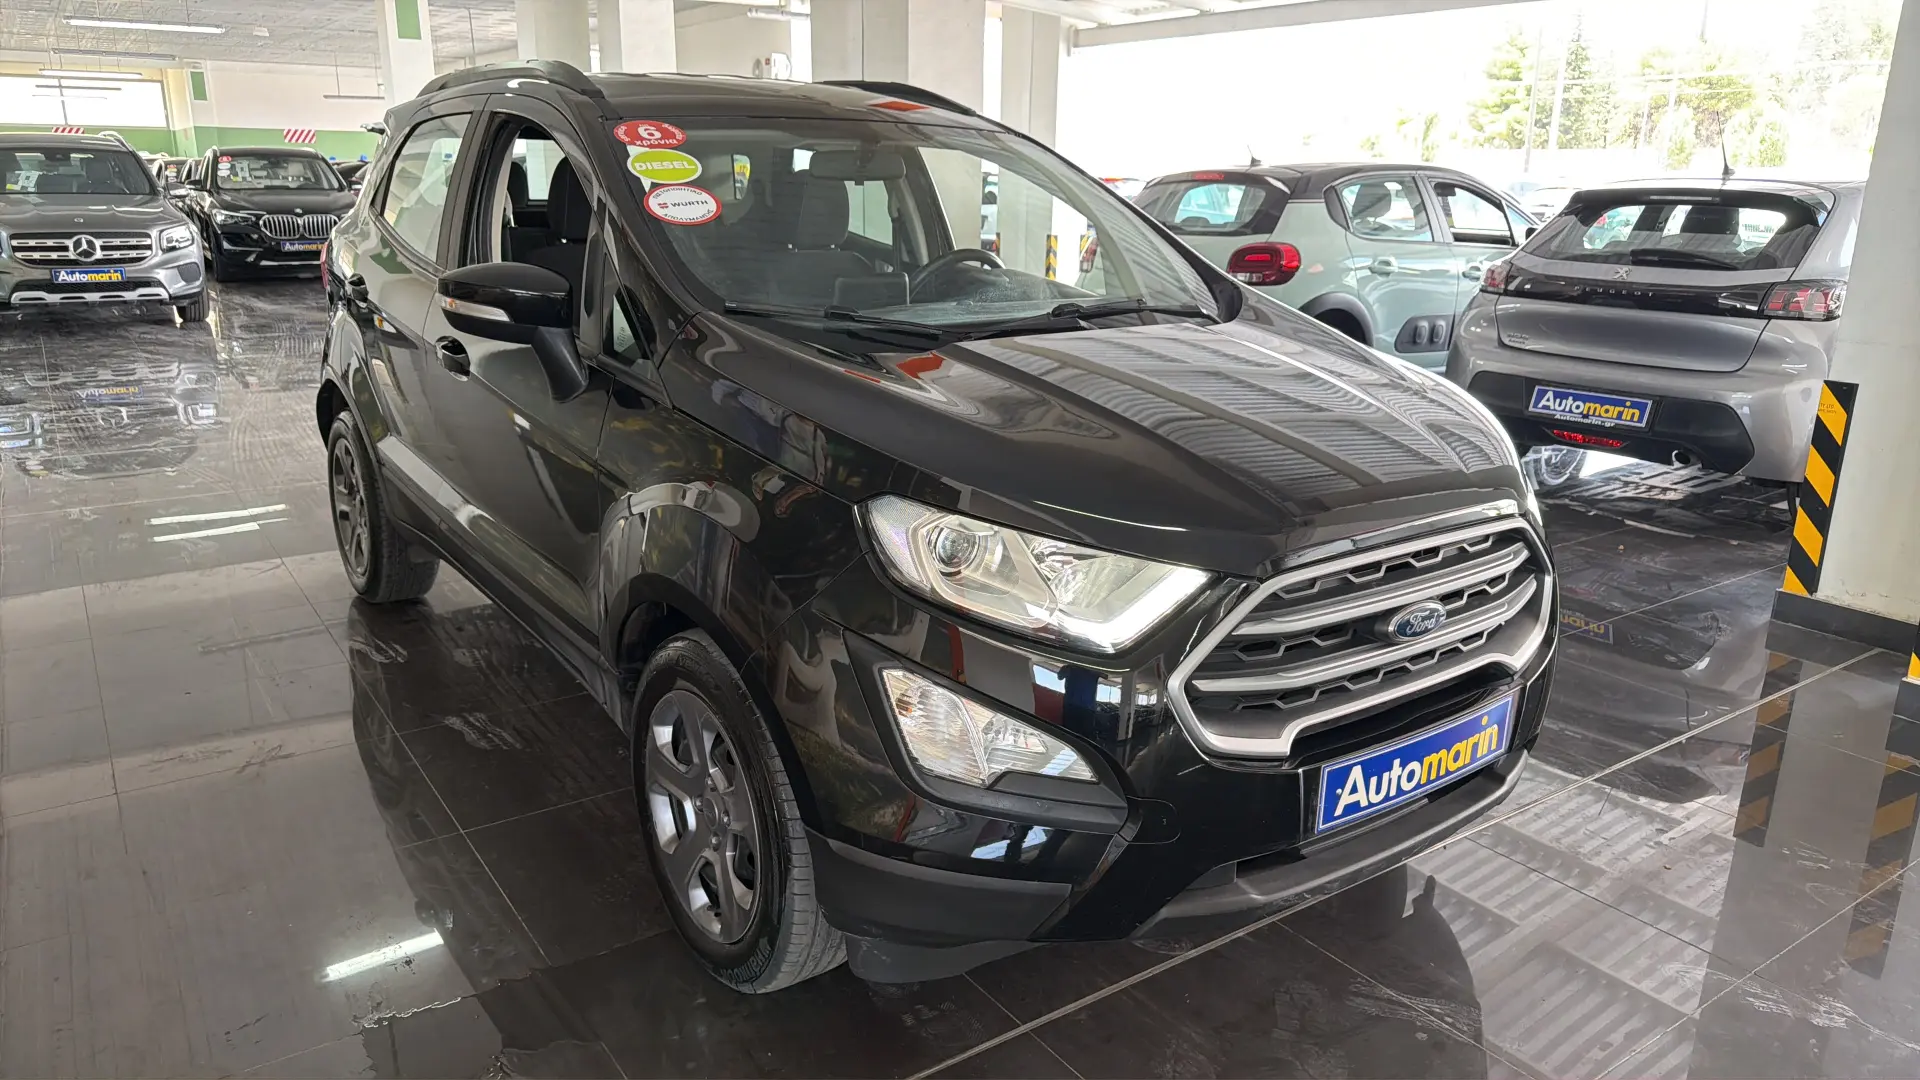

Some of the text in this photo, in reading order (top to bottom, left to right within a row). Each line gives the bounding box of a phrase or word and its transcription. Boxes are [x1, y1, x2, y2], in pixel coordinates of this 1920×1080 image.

[638, 126, 662, 140] 6
[634, 161, 695, 171] DIESEL
[59, 270, 122, 281] Automarin
[1574, 286, 1653, 297] PEUGEOT
[1537, 391, 1640, 421] Automarin
[1554, 414, 1616, 427] Automarin.gr
[1406, 612, 1437, 635] Ford
[1334, 715, 1499, 817] Automarin
